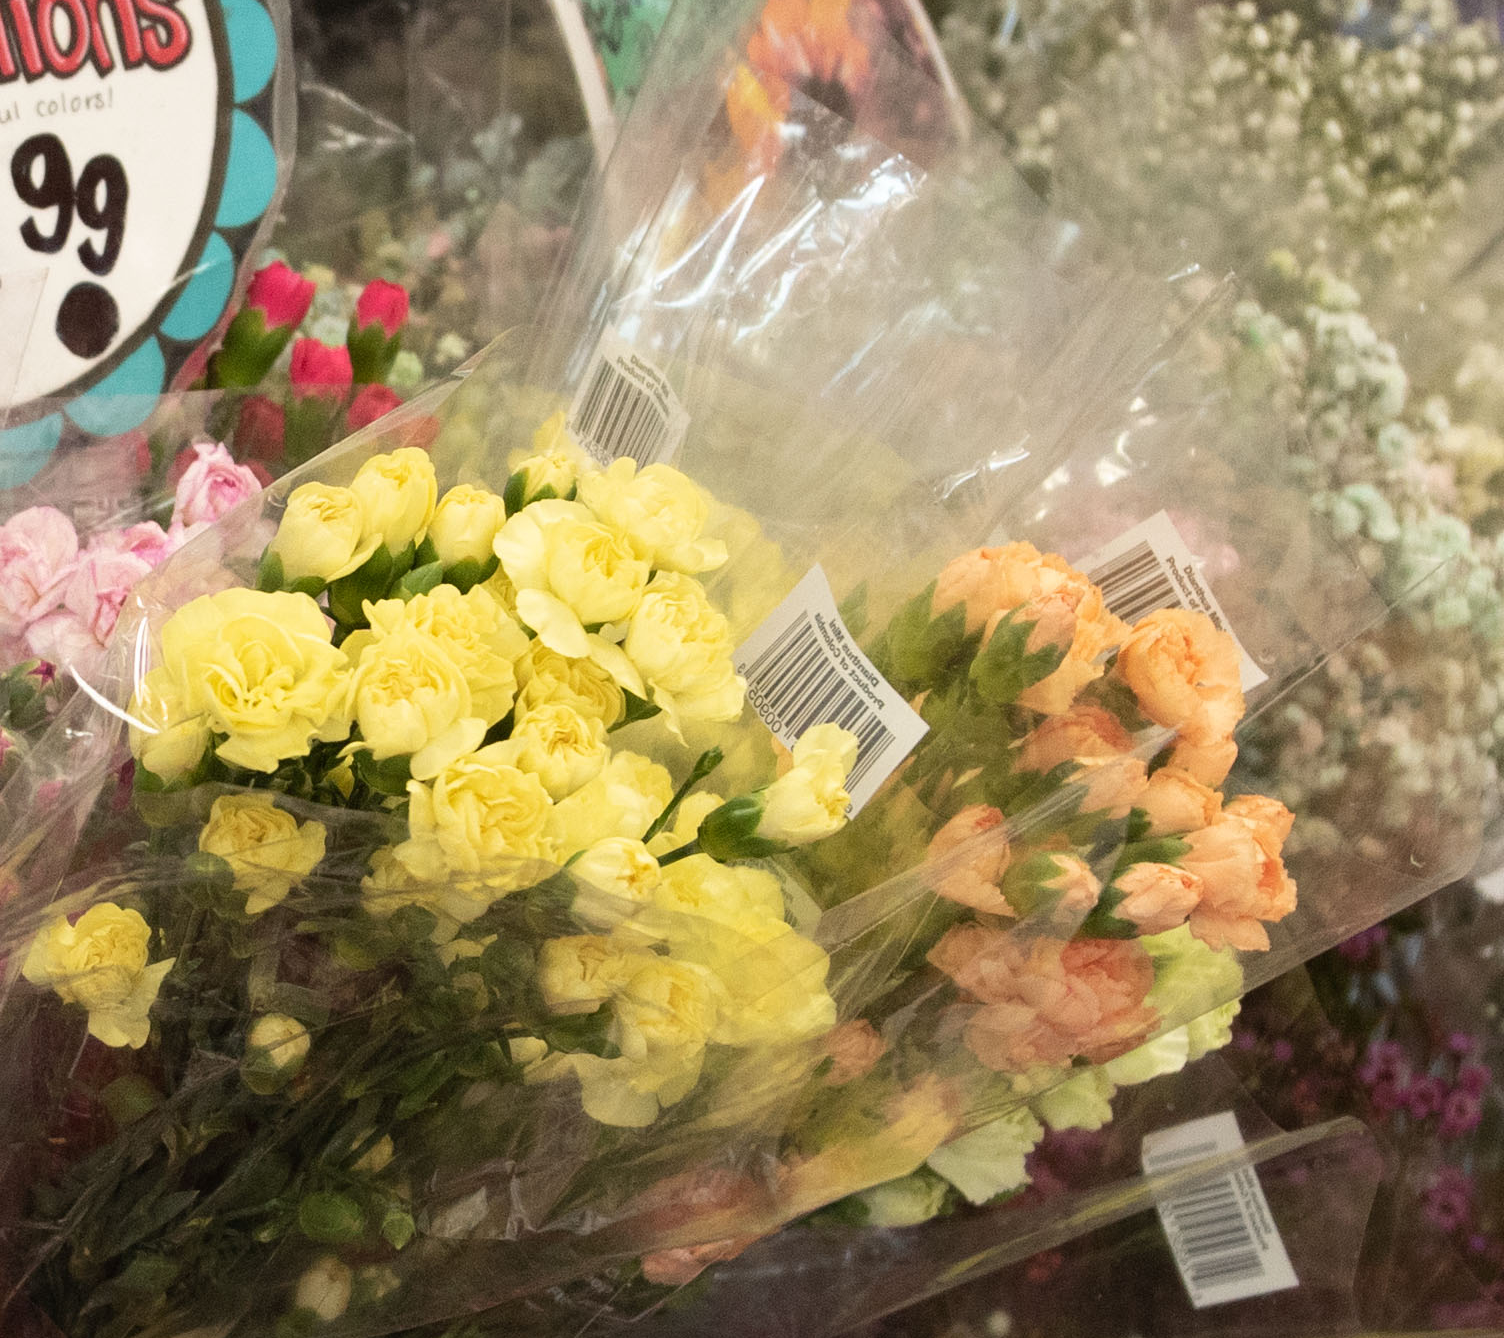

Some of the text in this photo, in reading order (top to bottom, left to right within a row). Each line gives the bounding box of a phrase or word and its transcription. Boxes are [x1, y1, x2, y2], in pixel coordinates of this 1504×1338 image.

[35, 86, 116, 120] colors!
[1164, 556, 1199, 610] Product of
[1183, 564, 1213, 612] Dianthus
